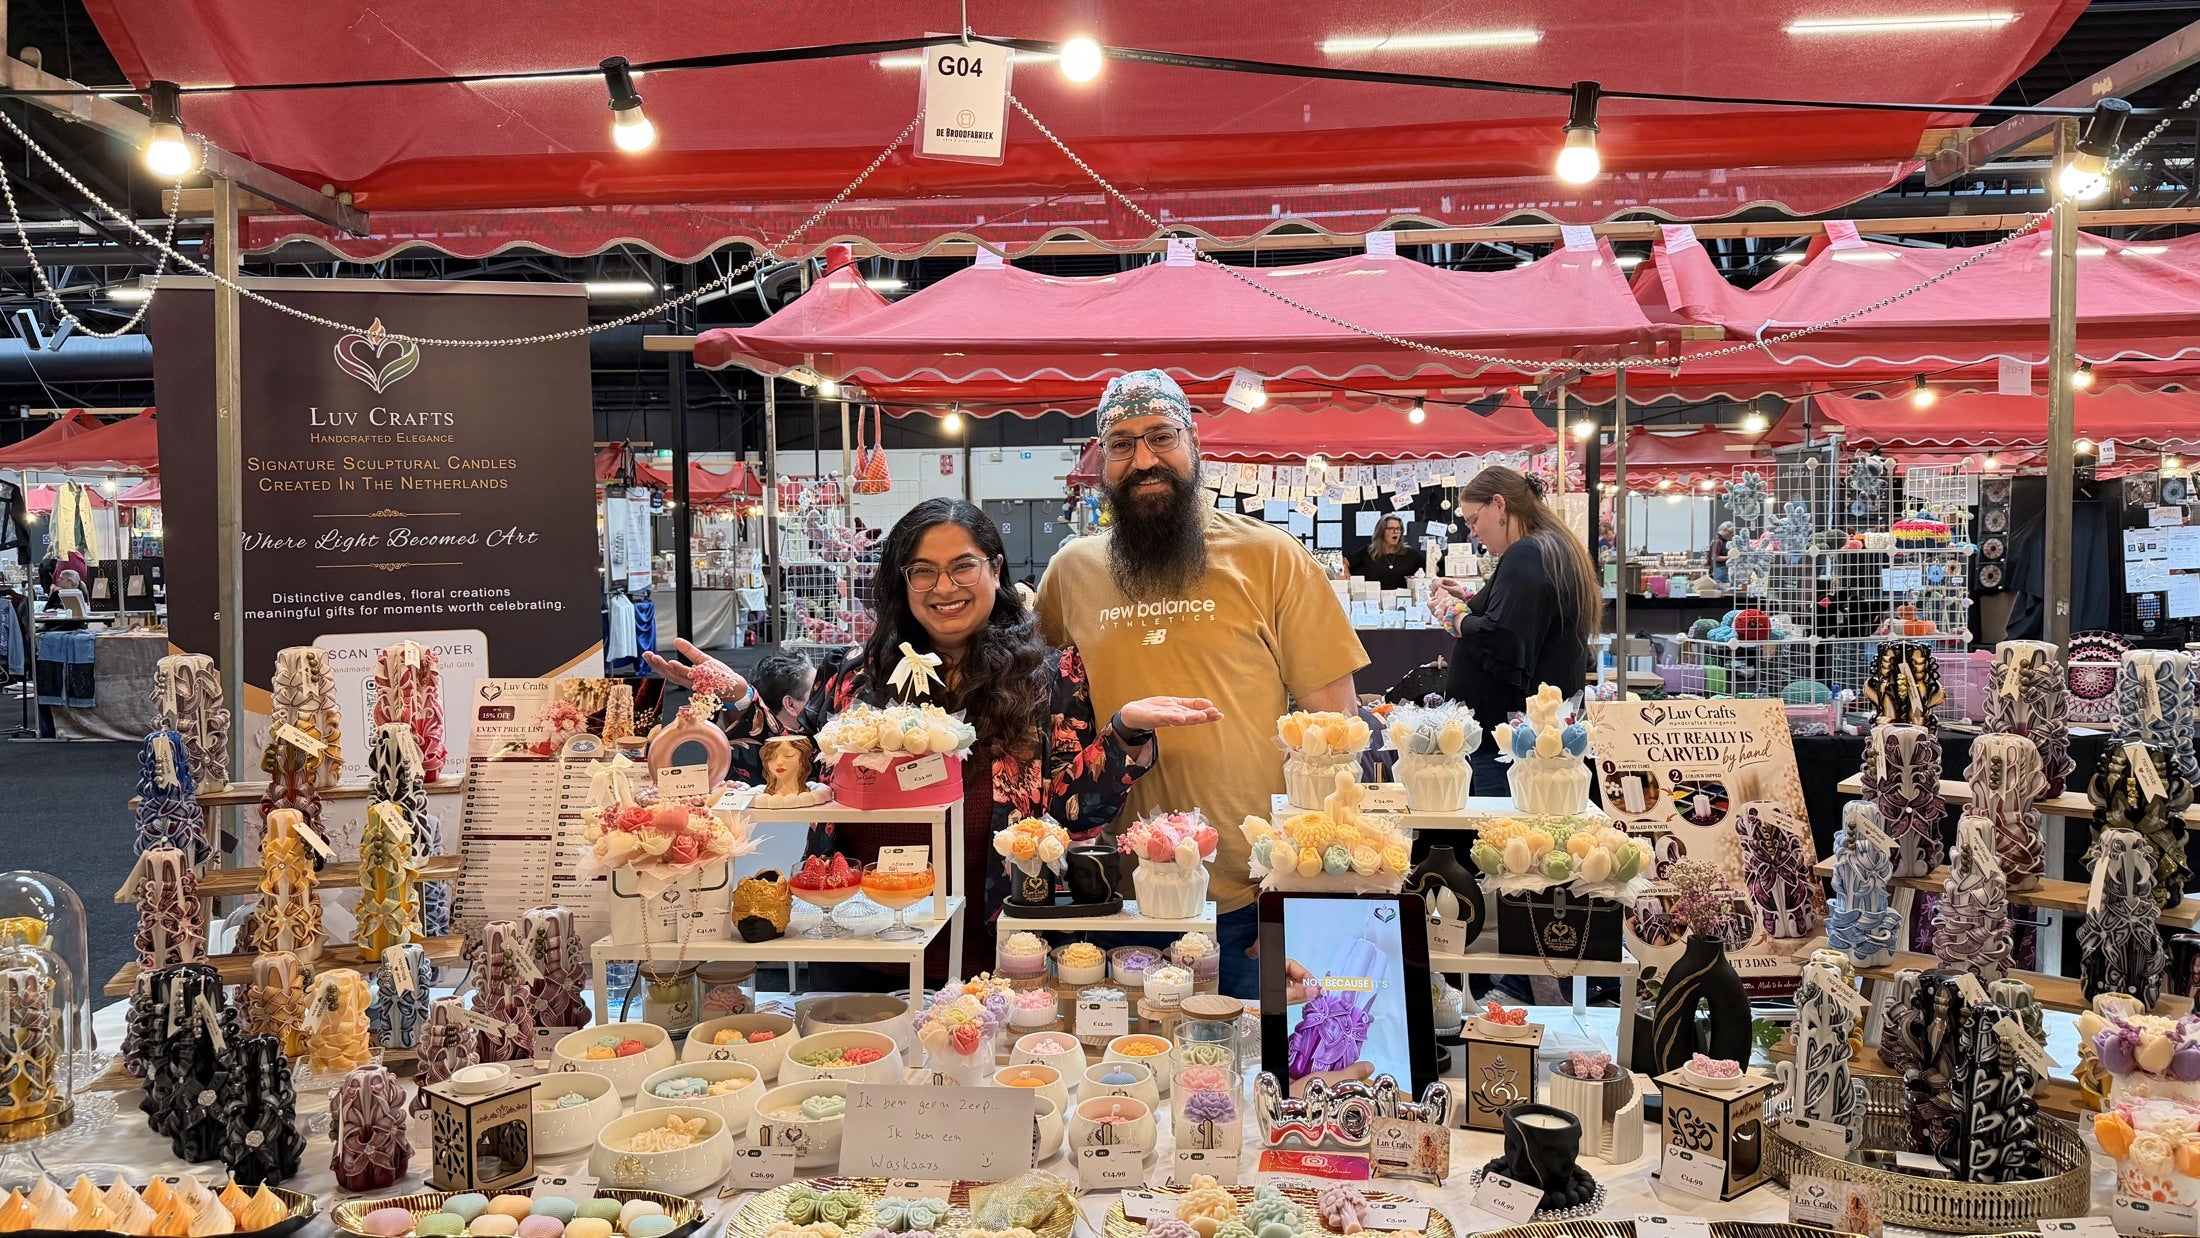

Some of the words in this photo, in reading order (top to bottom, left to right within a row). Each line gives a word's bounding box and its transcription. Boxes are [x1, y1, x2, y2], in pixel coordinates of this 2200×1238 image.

[938, 56, 983, 77] G04
[936, 128, 945, 137] DE
[241, 531, 308, 551] Where
[314, 528, 379, 552] Light
[386, 527, 479, 548] Becomes
[486, 526, 540, 547] Art
[272, 592, 347, 604] Distinctive
[349, 590, 407, 602] candles,
[410, 589, 445, 600] floral
[449, 587, 511, 599] creations
[244, 605, 321, 620] meaningful
[325, 604, 355, 617] gifts
[359, 604, 380, 615] for
[383, 603, 443, 615] moments
[448, 602, 485, 613] worth
[489, 599, 567, 614] celebrating.
[1099, 604, 1134, 622] new
[1137, 597, 1216, 618] balance
[1099, 614, 1216, 631] ATHLETICS
[328, 648, 368, 660] SCAN
[456, 661, 475, 669] Gifts
[503, 682, 520, 691] Luv
[522, 681, 549, 691] Crafts
[1667, 705, 1693, 720] Luv
[1695, 704, 1737, 719] Crafts
[1632, 732, 1664, 747] YES,
[1666, 732, 1683, 745] IT
[1684, 731, 1737, 745] REALLY
[1740, 730, 1754, 743] IS
[1647, 746, 1719, 762] CARVED
[1722, 745, 1737, 773] by
[1739, 739, 1773, 763] hand
[1606, 762, 1612, 772] 1
[1671, 770, 1680, 781] 2
[1745, 959, 1751, 968] 3
[1753, 957, 1777, 968] DAYS
[1302, 978, 1322, 987] NOT
[1325, 978, 1369, 988] BECAUSE
[1371, 979, 1388, 989] IT'S
[1826, 977, 1855, 999] Handmade
[2015, 1032, 2044, 1059] Handmade
[856, 1091, 873, 1109] Ik
[884, 1098, 907, 1108] ben
[919, 1101, 950, 1115] geen
[887, 1124, 903, 1139] Ik
[914, 1129, 934, 1140] ben
[942, 1133, 962, 1142] een
[1376, 1138, 1390, 1148] Luv
[1391, 1139, 1412, 1150] Crafts
[1794, 1196, 1812, 1206] Luv
[1813, 1197, 1838, 1211] Crafts
